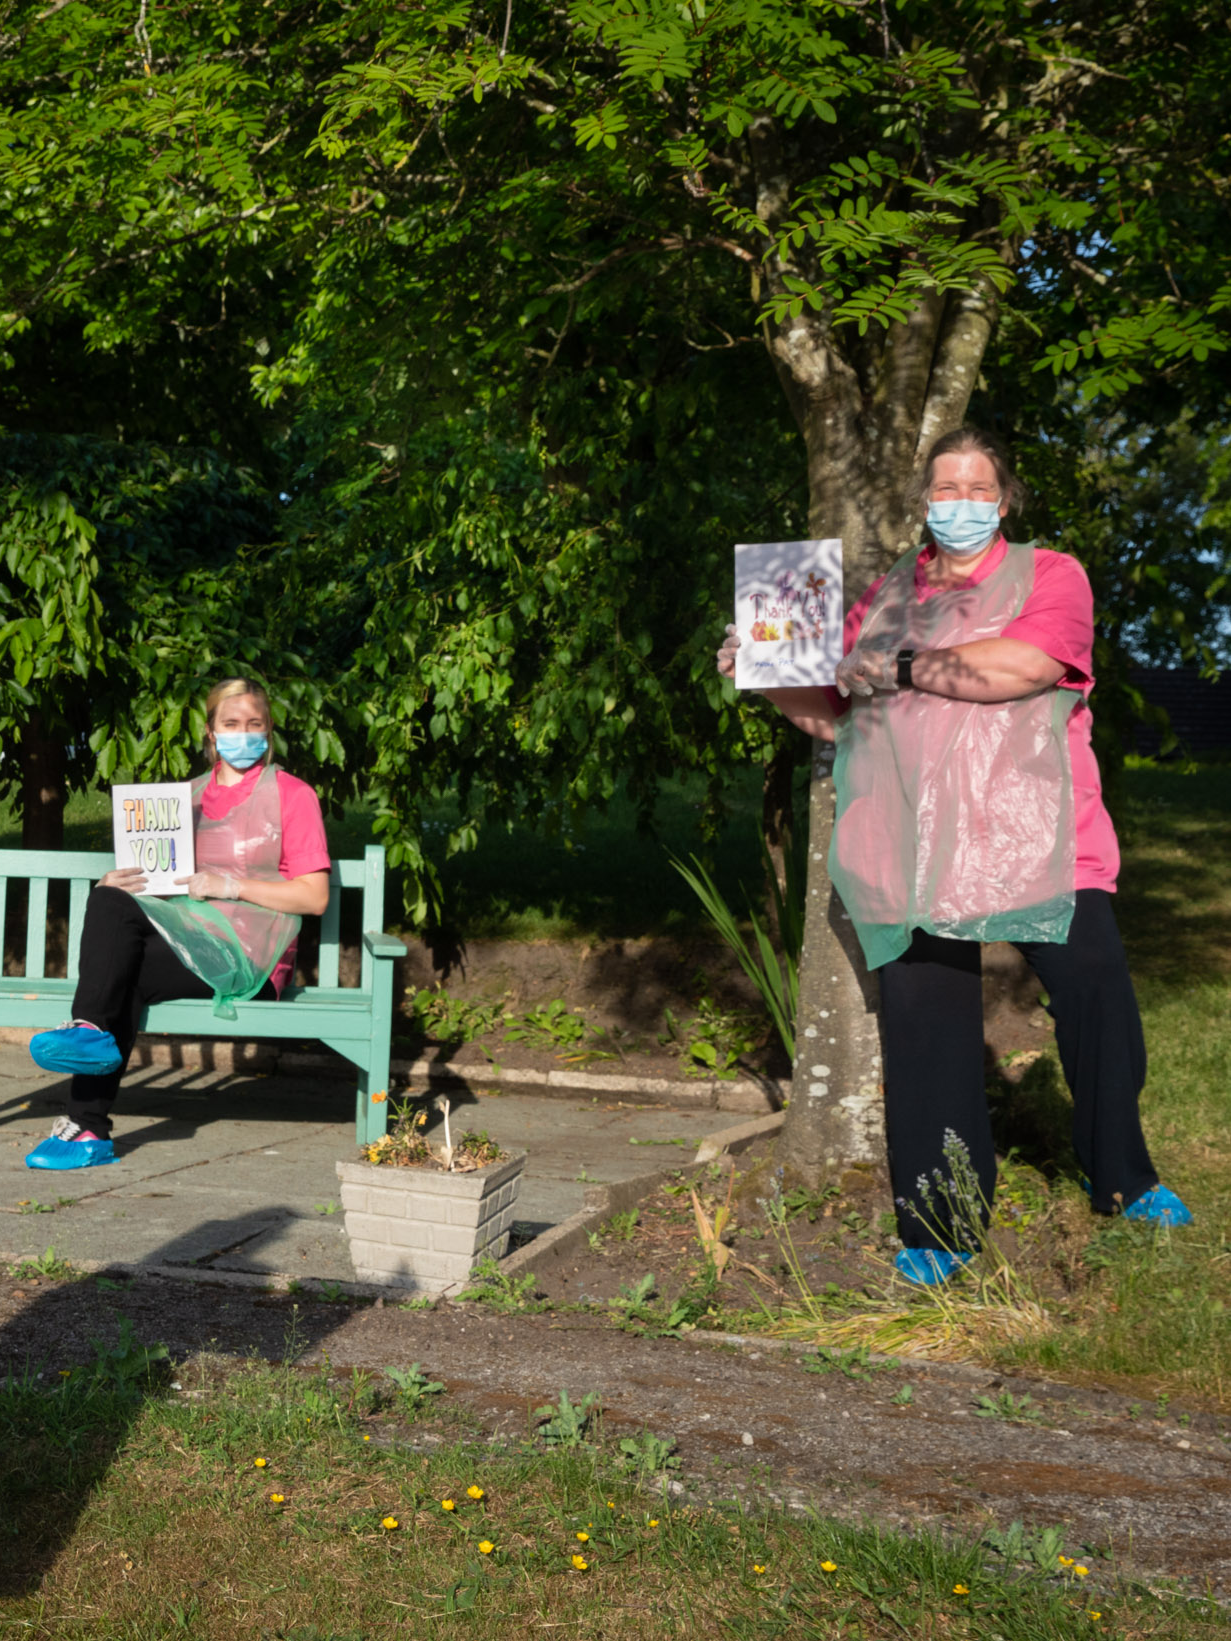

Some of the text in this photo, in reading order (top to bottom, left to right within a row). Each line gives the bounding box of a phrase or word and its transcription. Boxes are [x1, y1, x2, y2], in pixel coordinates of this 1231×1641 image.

[750, 591, 792, 619] Thank
[123, 798, 181, 832] THANK
[130, 838, 176, 872] YOU!
